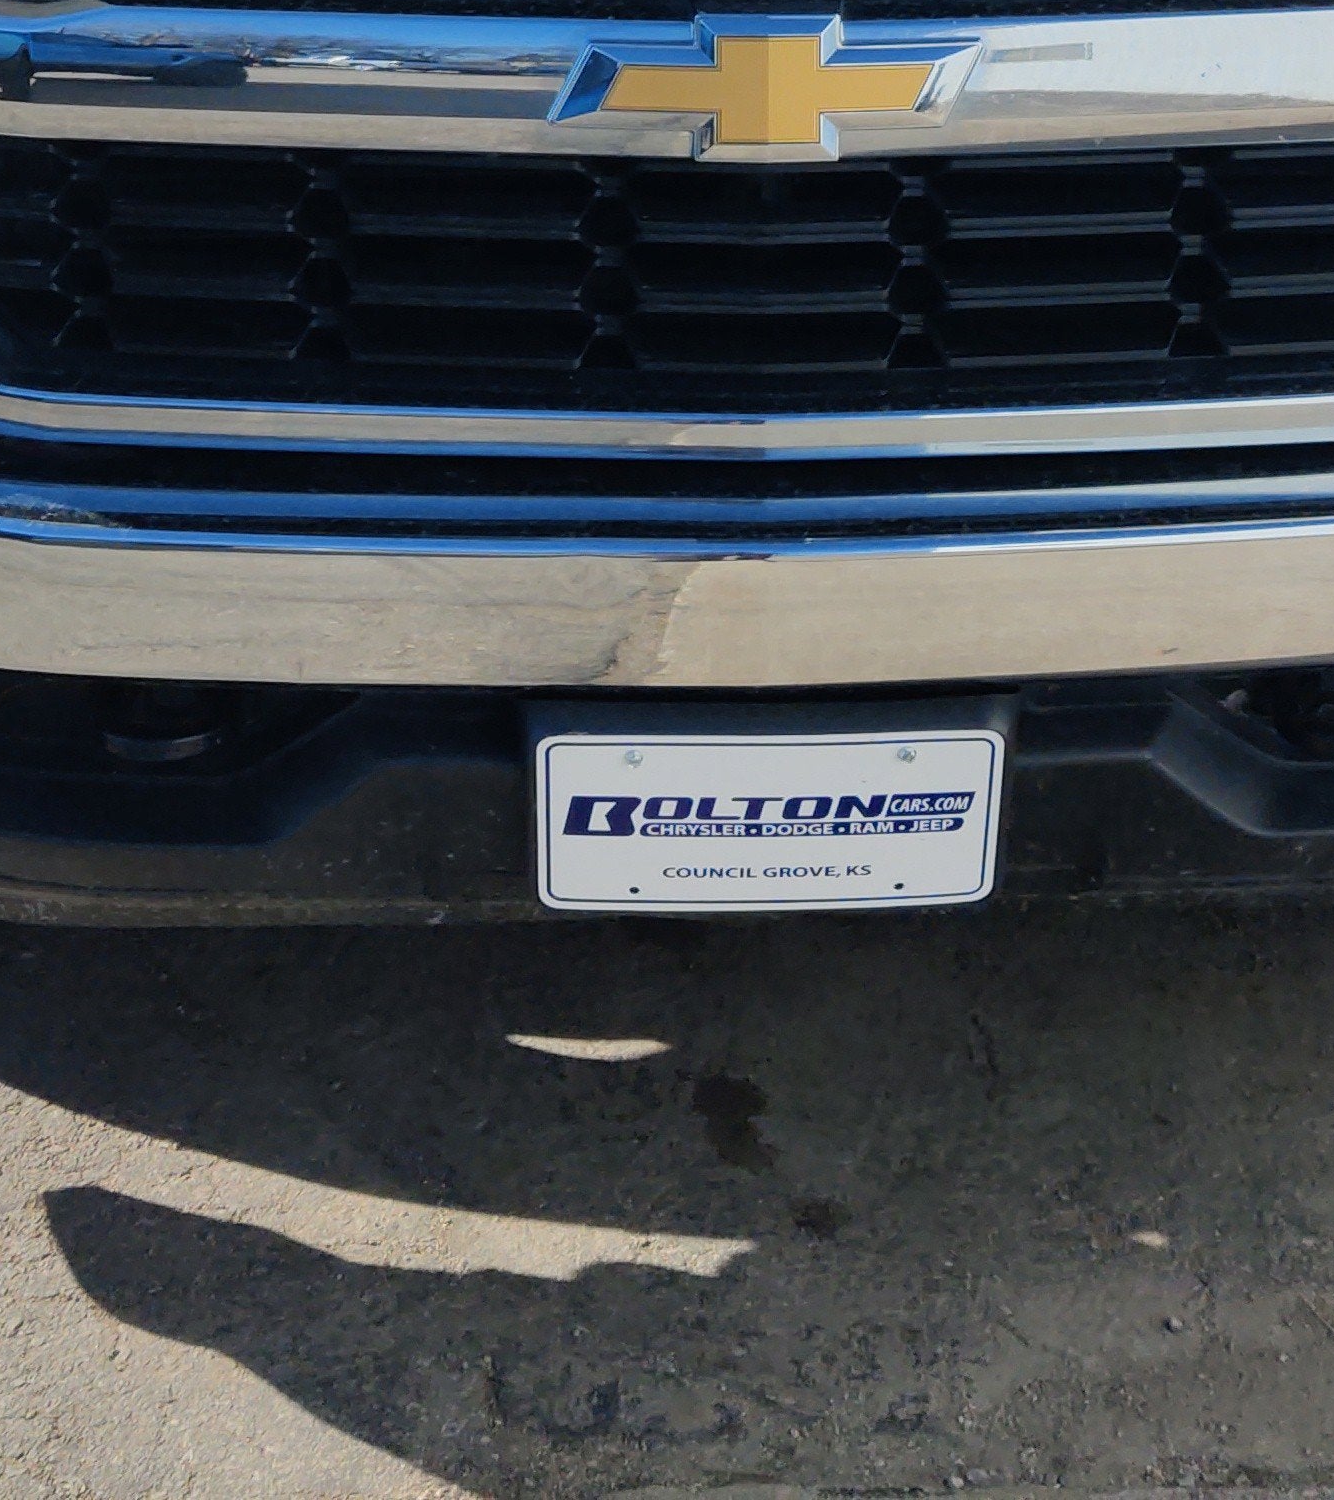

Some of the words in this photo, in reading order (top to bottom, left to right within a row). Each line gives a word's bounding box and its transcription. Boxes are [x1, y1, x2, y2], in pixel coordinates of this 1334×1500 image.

[562, 794, 888, 836] BOLTON
[890, 796, 970, 814] CARS.COM
[647, 824, 746, 836] CHRYSLER
[761, 824, 834, 836] DODGE
[849, 821, 895, 834] RAM
[909, 818, 954, 832] JEEP
[662, 867, 758, 879] COUNCIL
[763, 866, 841, 880] GROVE,
[846, 864, 872, 877] KS
